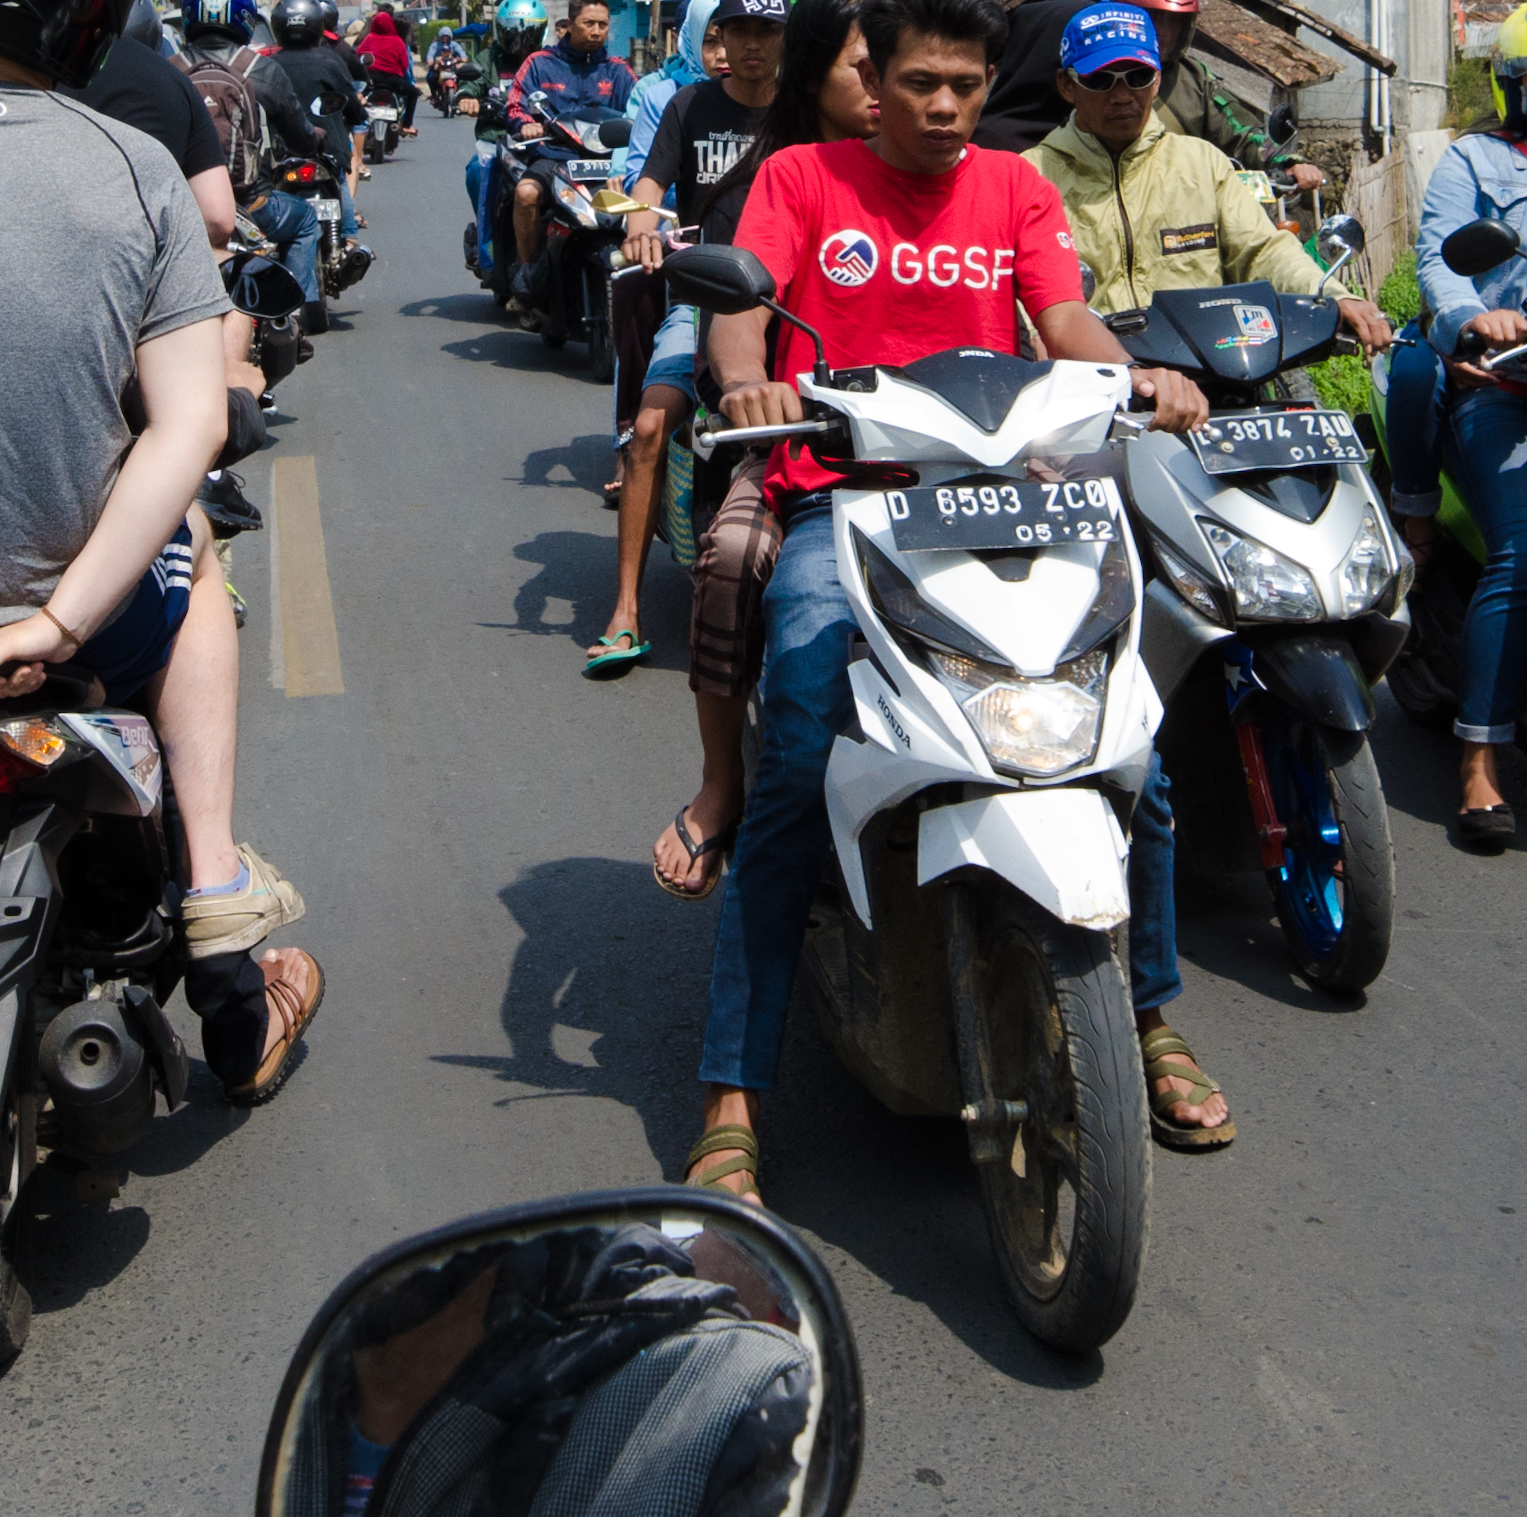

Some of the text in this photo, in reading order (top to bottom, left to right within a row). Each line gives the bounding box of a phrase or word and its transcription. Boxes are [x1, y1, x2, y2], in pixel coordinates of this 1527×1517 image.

[1100, 10, 1144, 21] INFINITI
[1084, 30, 1147, 46] RACING
[1227, 417, 1292, 442] 3874
[1300, 415, 1353, 437] ZAU
[886, 490, 910, 520] D
[936, 486, 1022, 516] 6593
[877, 693, 911, 750] HONDA
